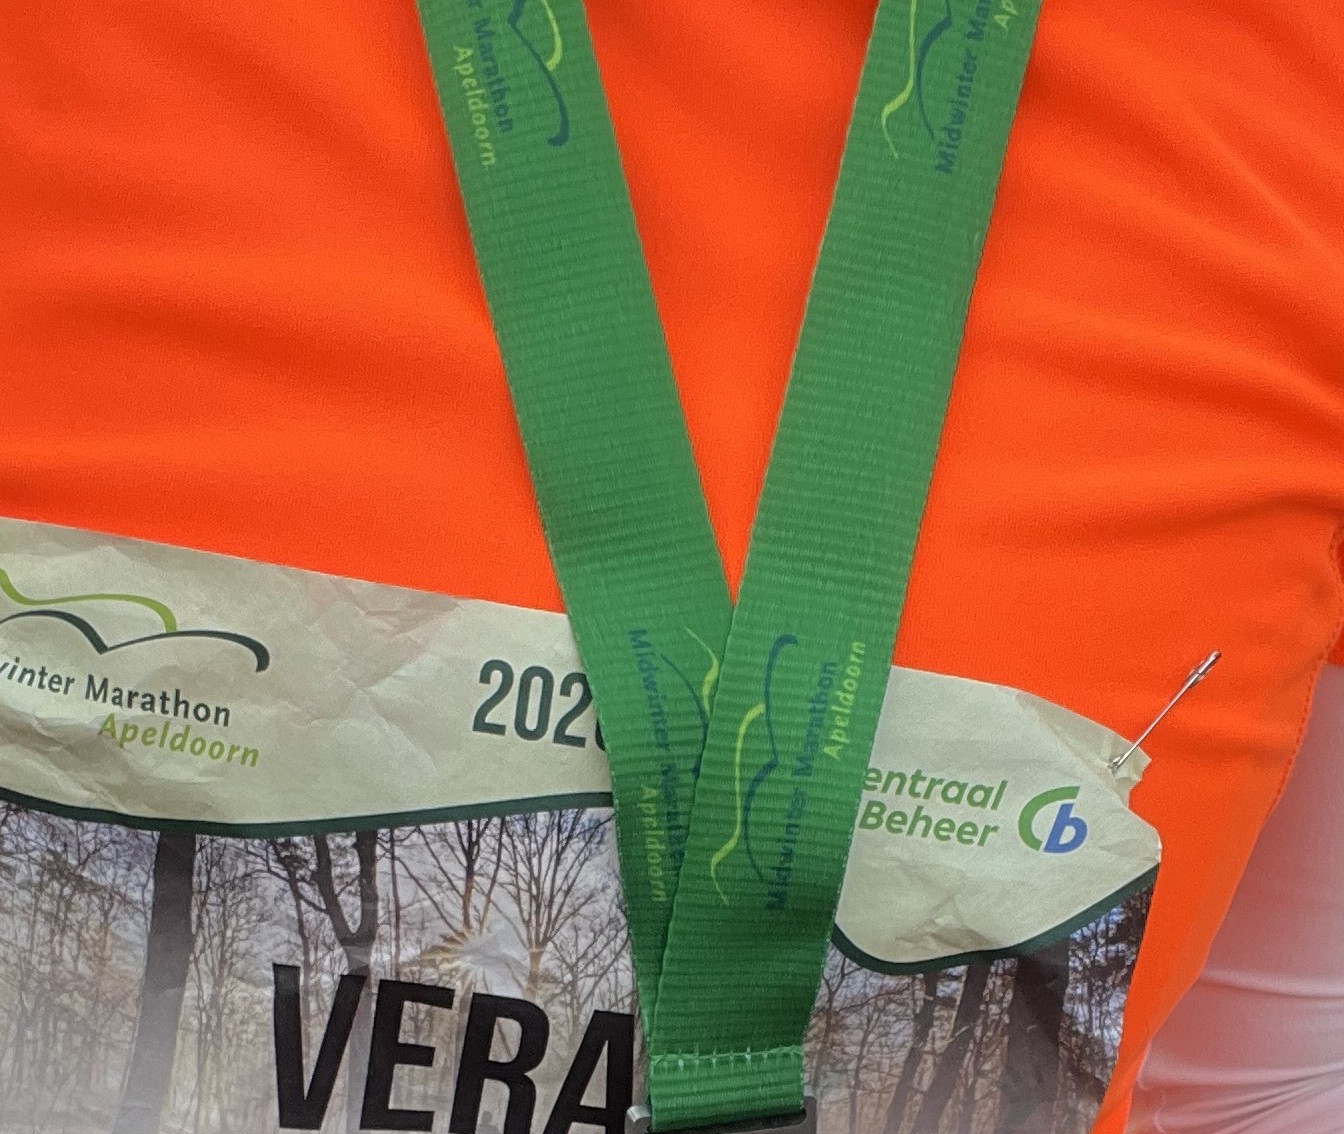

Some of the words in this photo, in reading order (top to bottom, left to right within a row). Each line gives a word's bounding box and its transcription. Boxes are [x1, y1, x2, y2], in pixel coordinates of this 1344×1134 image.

[453, 44, 497, 166] Apeldoorn
[84, 674, 231, 727] Marathon
[472, 658, 607, 752] 202
[823, 640, 866, 760] Apeldoorn
[97, 712, 261, 768] Apeldoorn
[862, 767, 1009, 812] entraal
[858, 800, 1000, 848] Beheer
